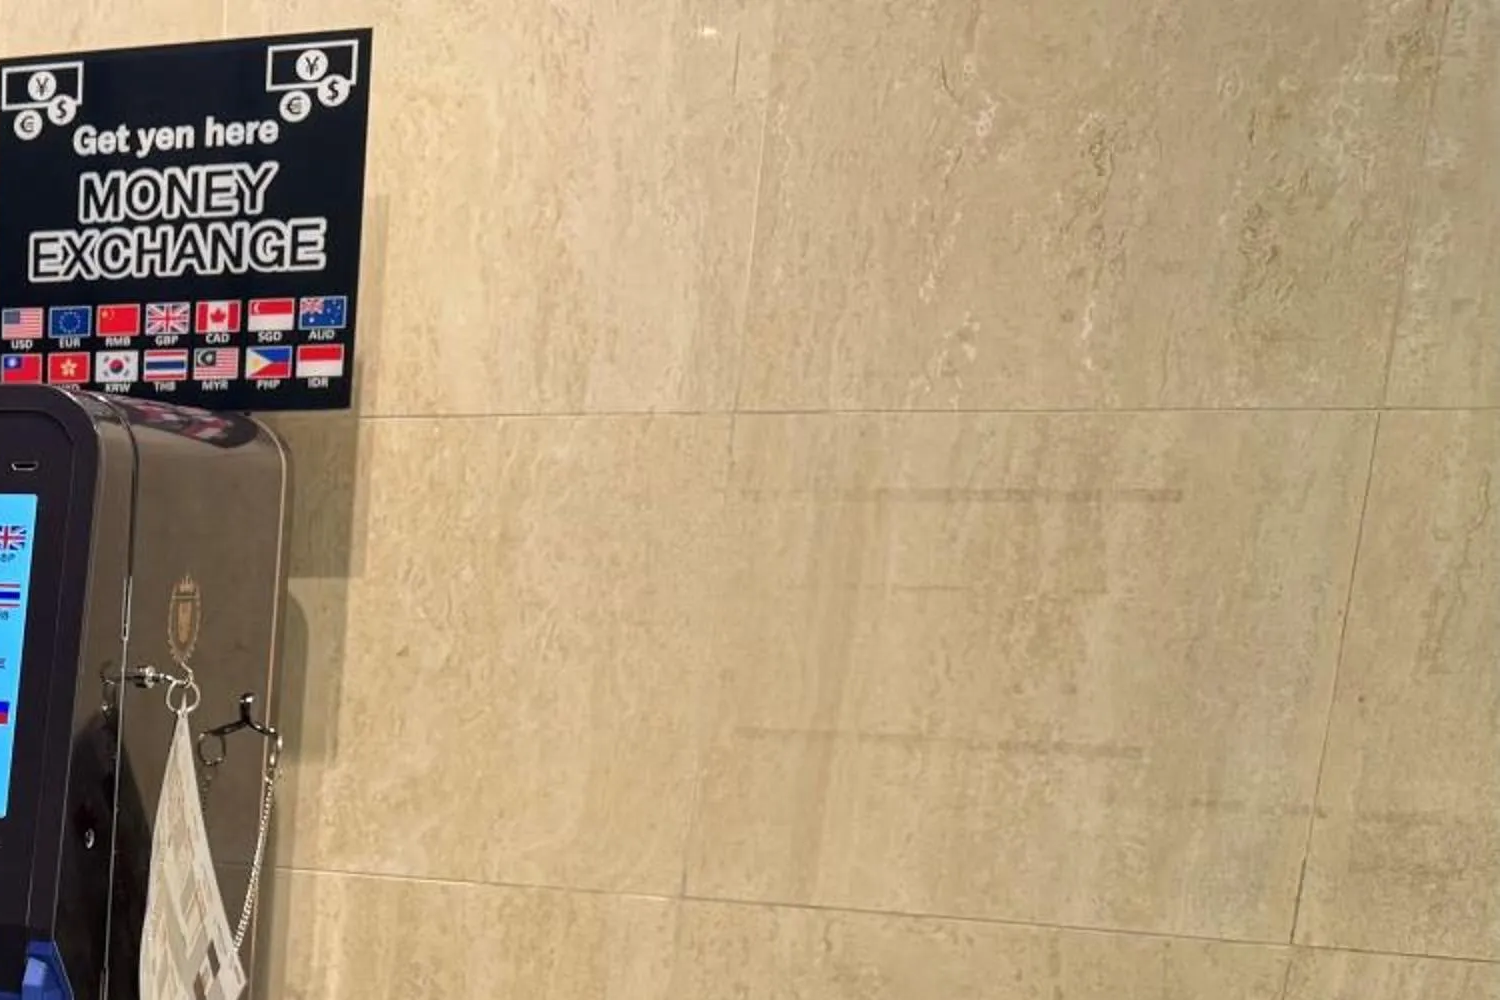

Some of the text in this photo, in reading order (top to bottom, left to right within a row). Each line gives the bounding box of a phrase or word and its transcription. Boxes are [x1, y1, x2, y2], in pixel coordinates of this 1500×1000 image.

[73, 115, 280, 158] Get yen here
[78, 160, 279, 225] MONEY
[27, 217, 327, 283] EXCHANGE
[10, 329, 336, 350] USD EUR RMB GBP CAD SGD AUD
[105, 383, 131, 393] KRW
[307, 377, 329, 389] IDR
